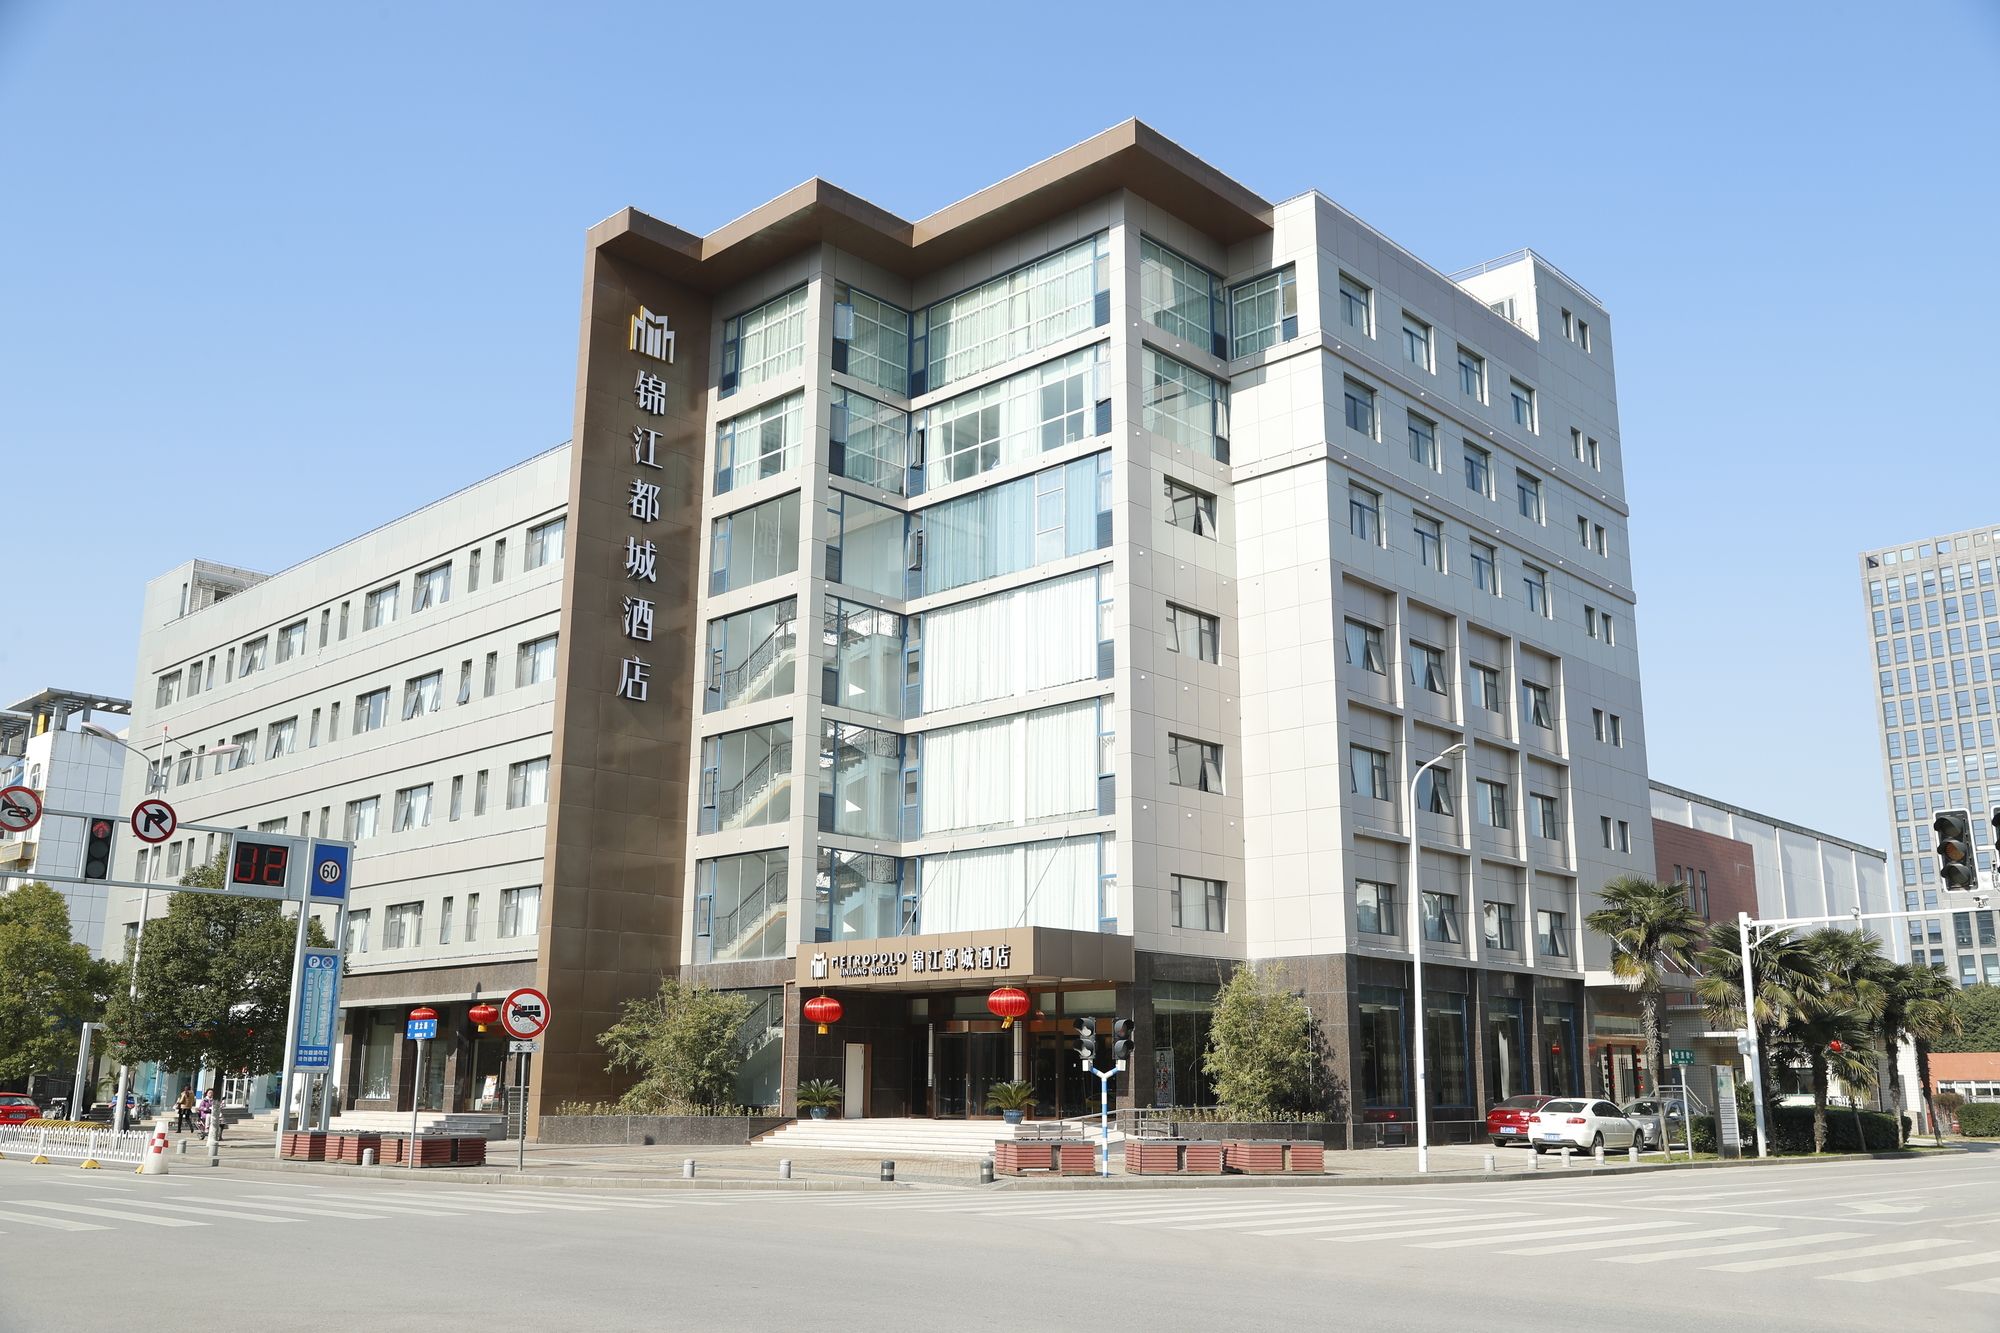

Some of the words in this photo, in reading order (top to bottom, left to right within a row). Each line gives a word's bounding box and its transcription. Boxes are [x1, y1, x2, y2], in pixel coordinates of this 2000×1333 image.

[615, 368, 668, 703] 锦江都城酒店
[322, 865, 337, 878] 60
[831, 951, 907, 968] METROPOLO
[911, 943, 1011, 974] 锦江都城酒店
[870, 965, 898, 977] HOTELS
